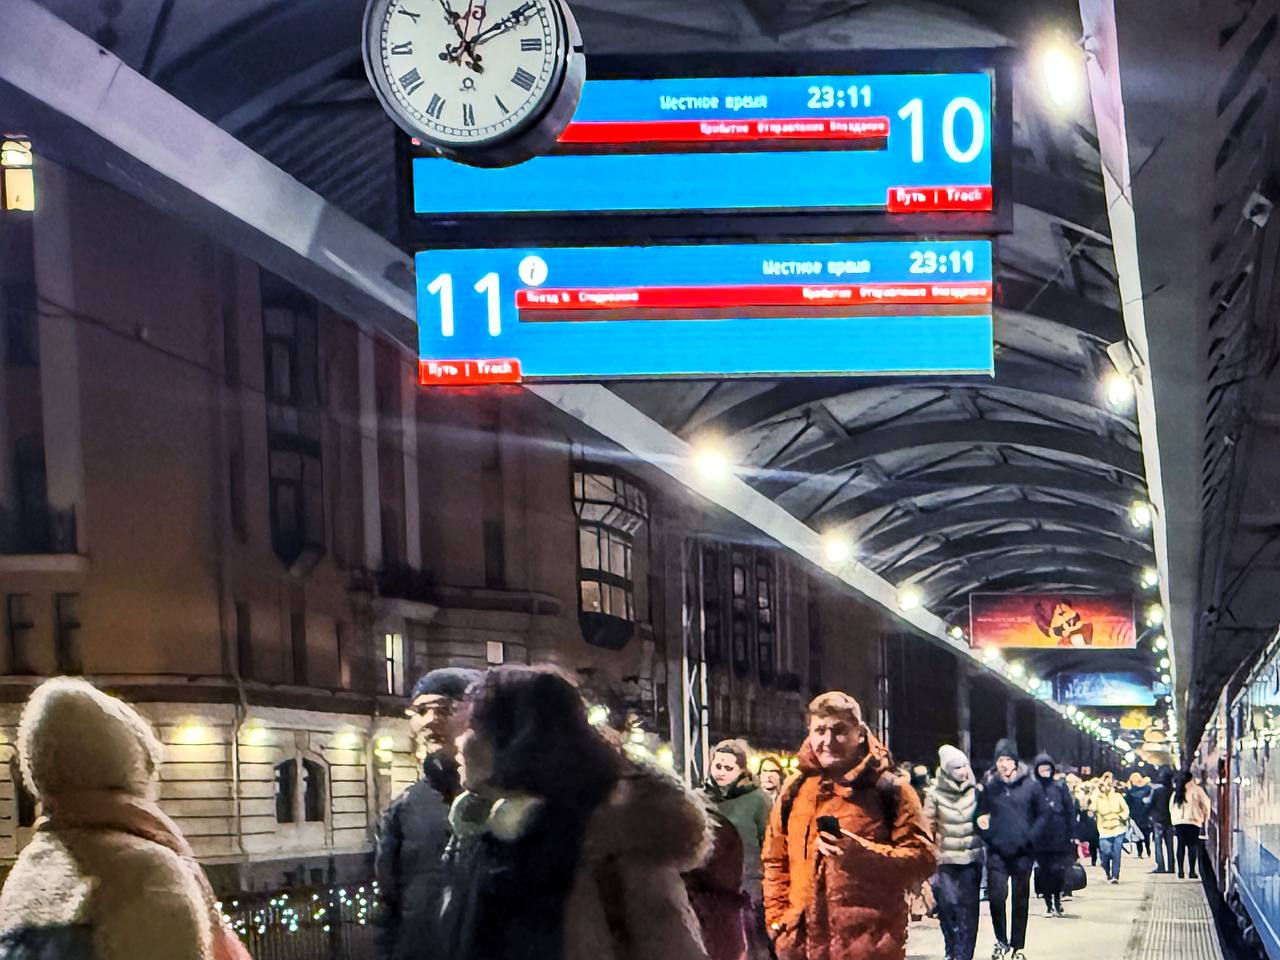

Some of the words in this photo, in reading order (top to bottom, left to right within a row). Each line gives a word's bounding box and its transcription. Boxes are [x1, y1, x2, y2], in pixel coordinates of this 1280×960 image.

[807, 85, 872, 109] 23:11
[897, 96, 985, 163] 10
[896, 186, 927, 206] Путь
[946, 186, 983, 202] Track
[909, 250, 974, 274] 23:11
[426, 271, 501, 337] 11
